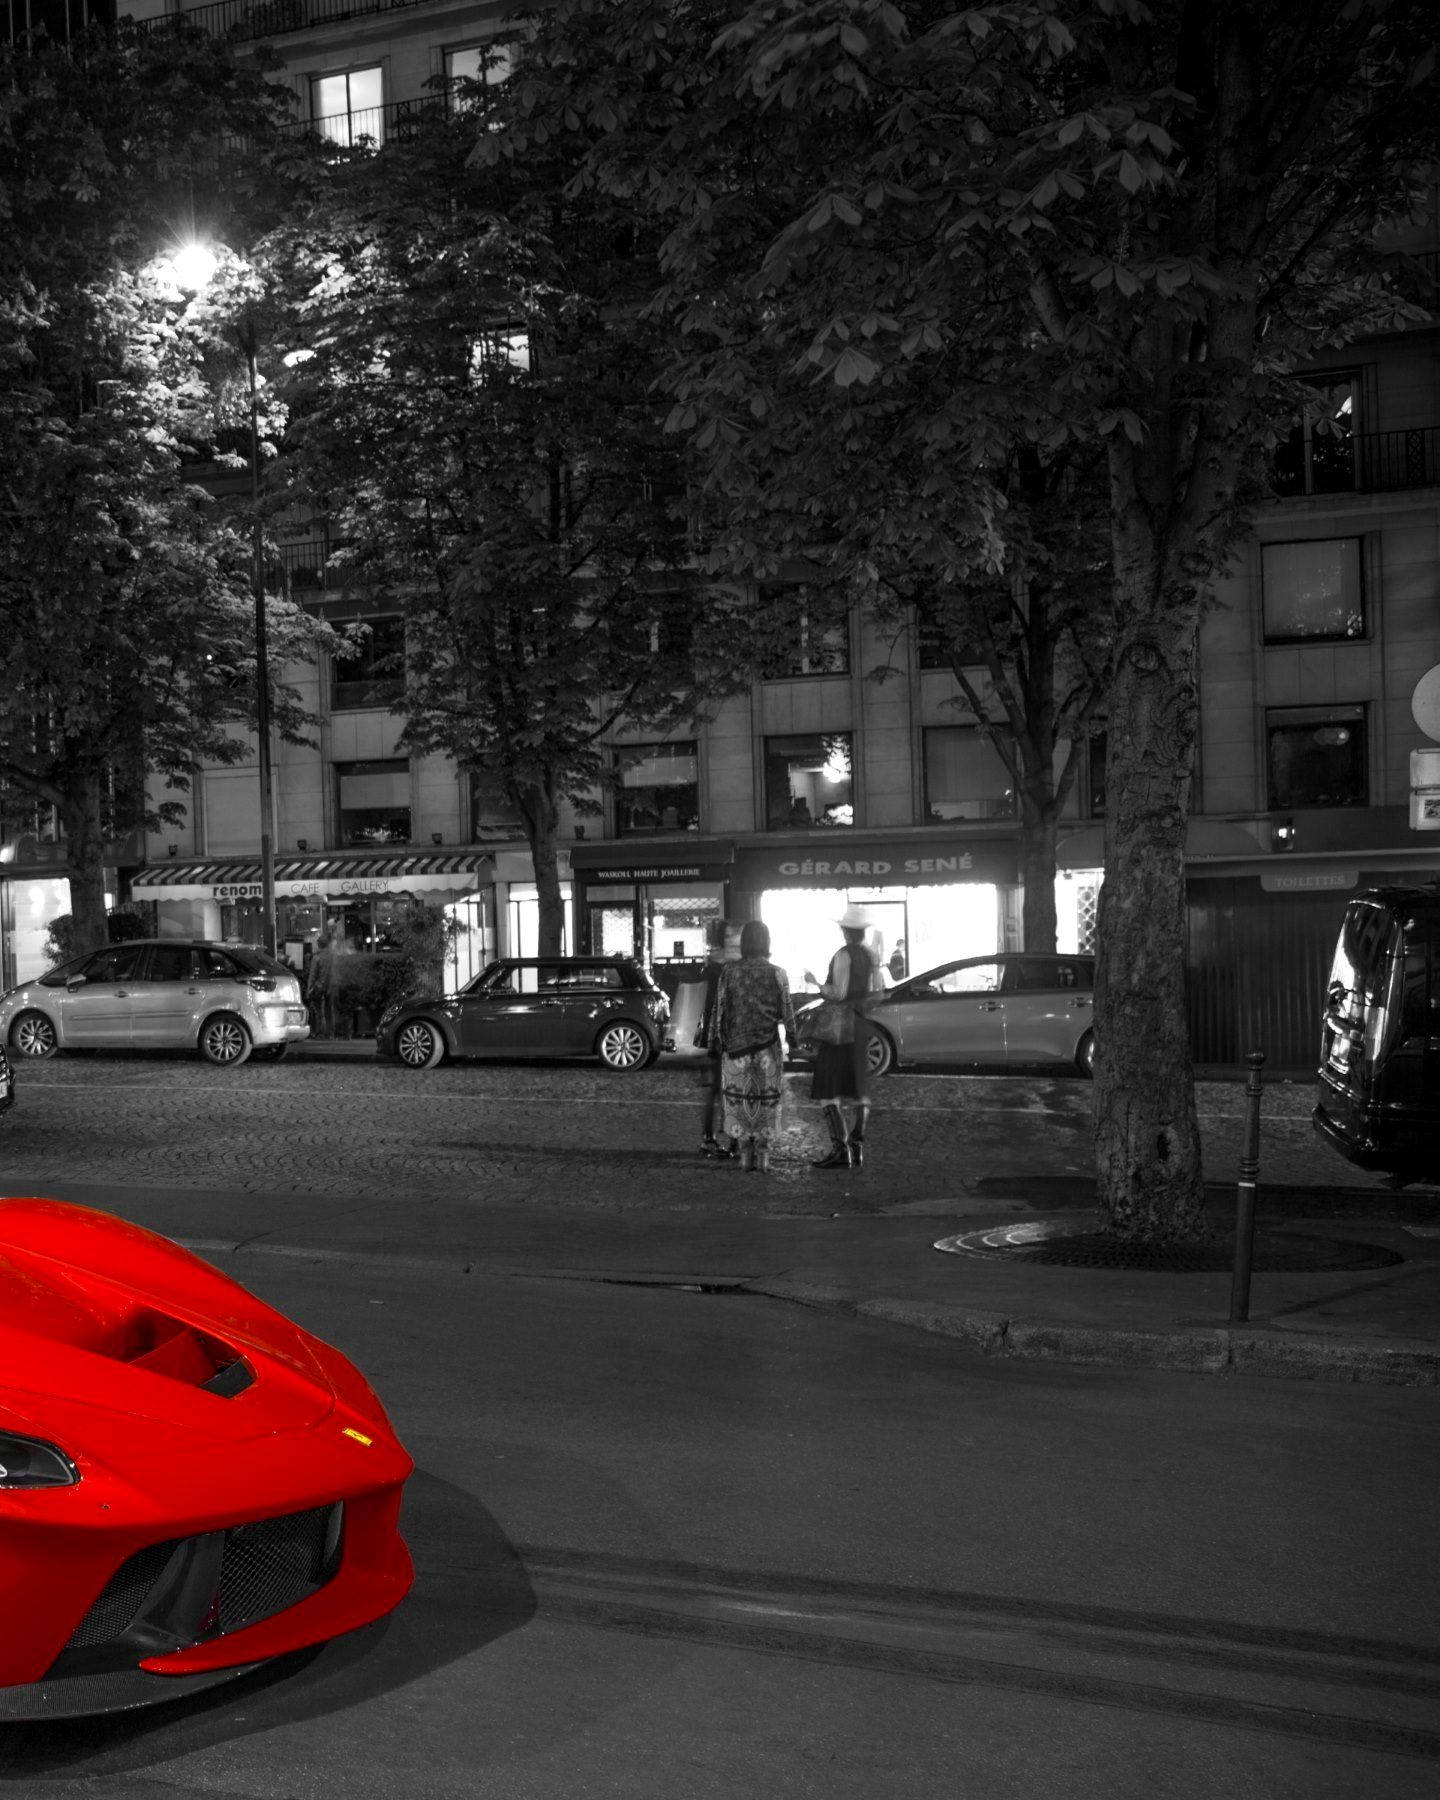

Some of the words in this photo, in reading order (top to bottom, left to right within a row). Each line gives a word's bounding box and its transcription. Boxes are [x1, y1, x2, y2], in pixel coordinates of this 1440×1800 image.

[778, 859, 892, 875] GÉRARD
[904, 852, 973, 873] SENÉ
[633, 869, 658, 877] HAUTE
[1274, 875, 1345, 887] TOILETTES
[213, 885, 262, 897] renom
[291, 883, 320, 894] CAFE
[341, 880, 389, 893] GALLERY
